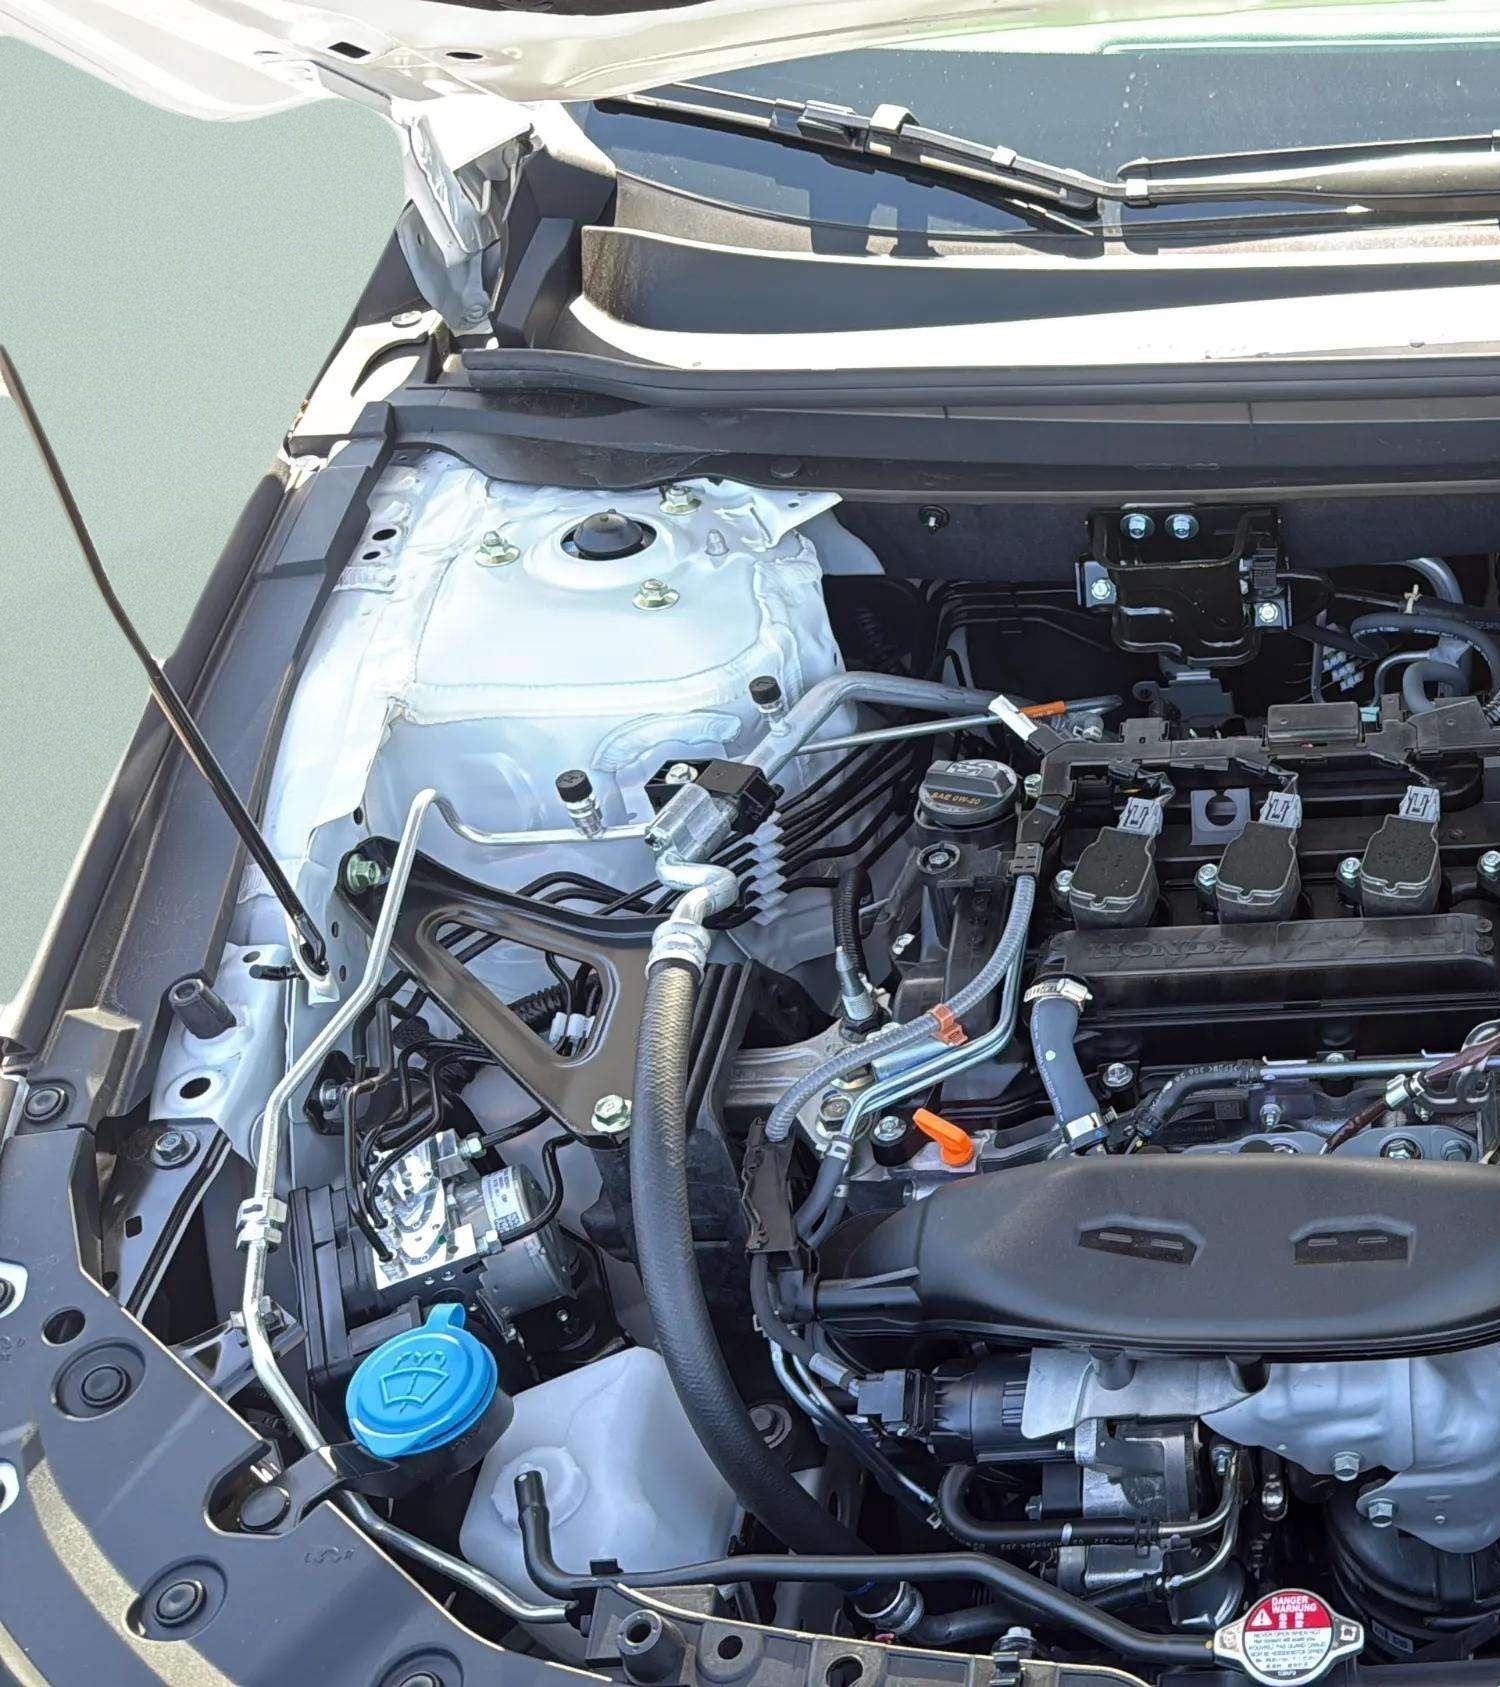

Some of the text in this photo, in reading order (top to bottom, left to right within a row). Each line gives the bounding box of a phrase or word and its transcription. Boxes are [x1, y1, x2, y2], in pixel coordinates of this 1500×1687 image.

[931, 791, 981, 804] SAE 0W-20
[1088, 940, 1249, 960] HONDA
[1271, 1596, 1309, 1605] DANGER
